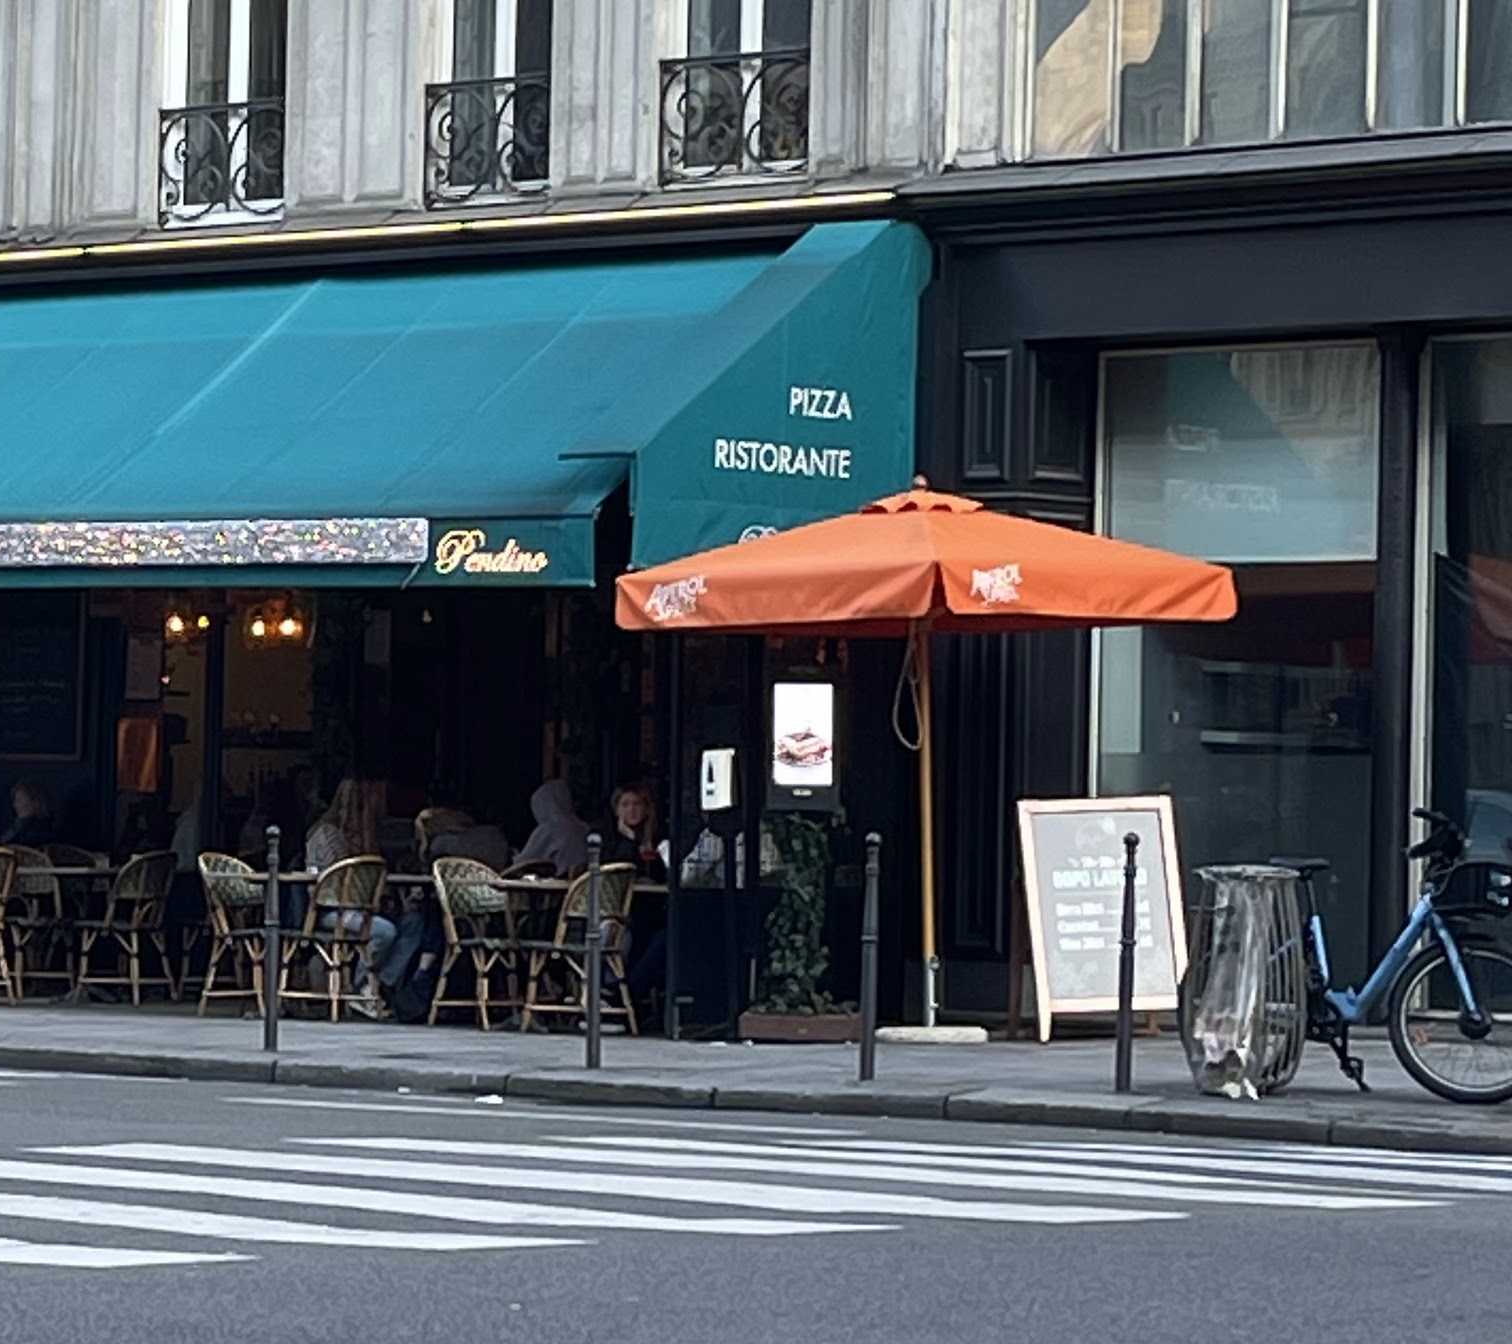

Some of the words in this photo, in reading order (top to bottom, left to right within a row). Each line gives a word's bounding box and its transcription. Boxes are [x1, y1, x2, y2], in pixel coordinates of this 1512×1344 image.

[789, 386, 852, 421] PIZZA
[714, 439, 852, 479] RISTORANTE
[434, 529, 548, 574] Pendino
